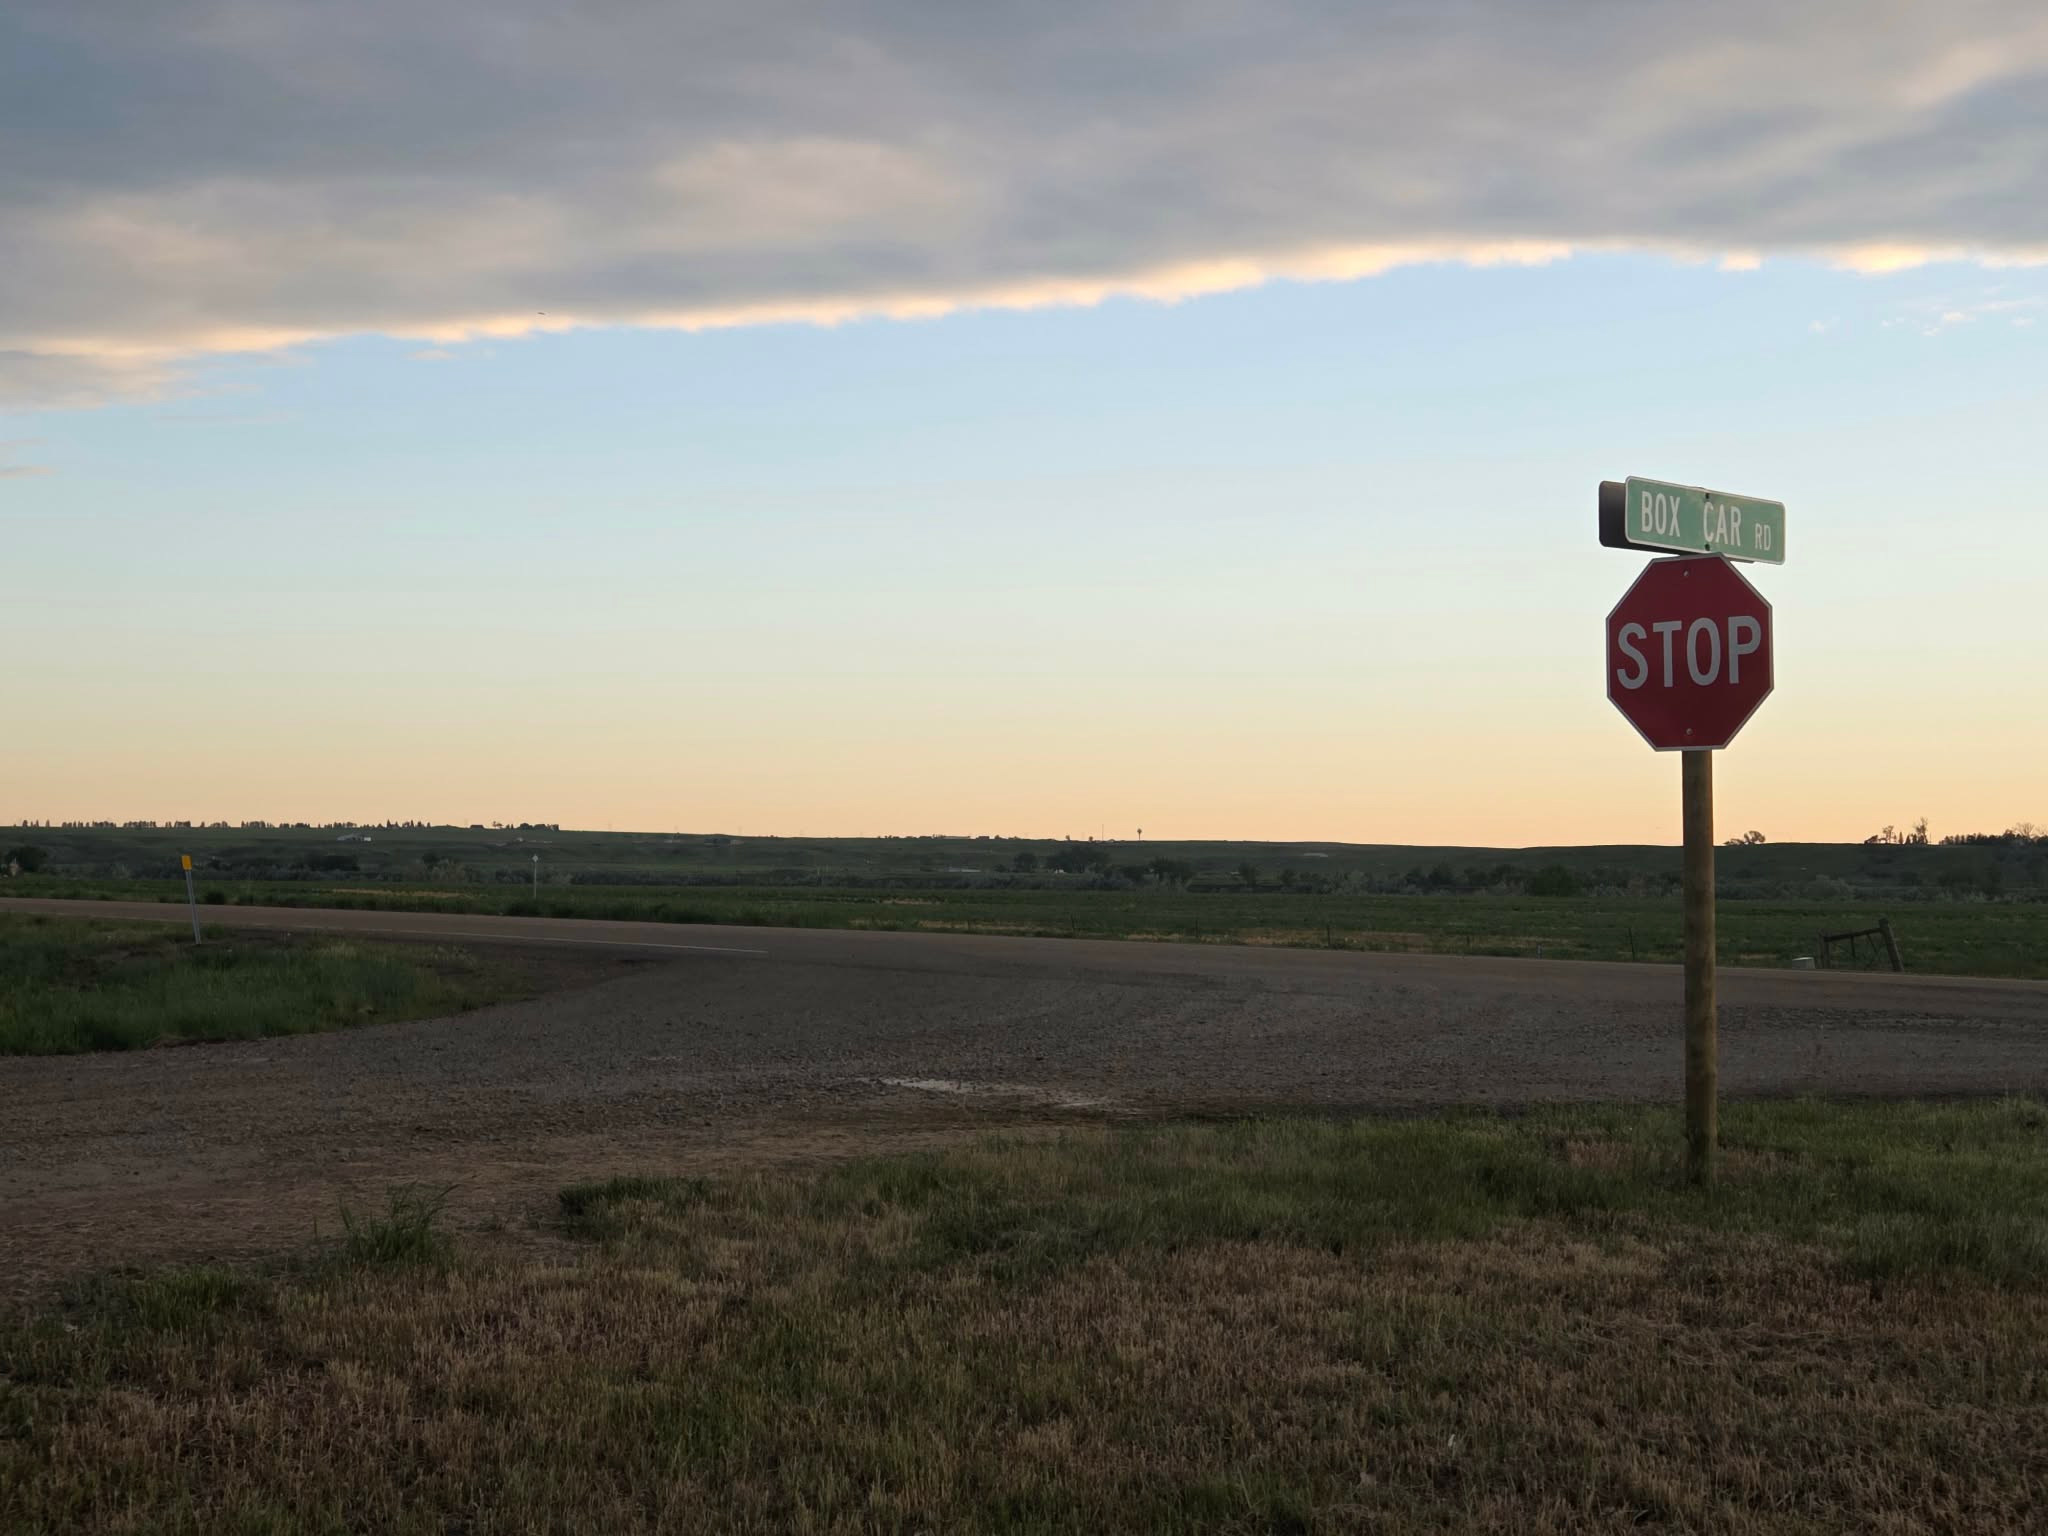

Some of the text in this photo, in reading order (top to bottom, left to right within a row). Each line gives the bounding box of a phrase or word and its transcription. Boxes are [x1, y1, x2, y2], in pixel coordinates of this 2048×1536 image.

[1641, 491, 1772, 551] BOX CAR RD
[1616, 615, 1762, 690] STOP
